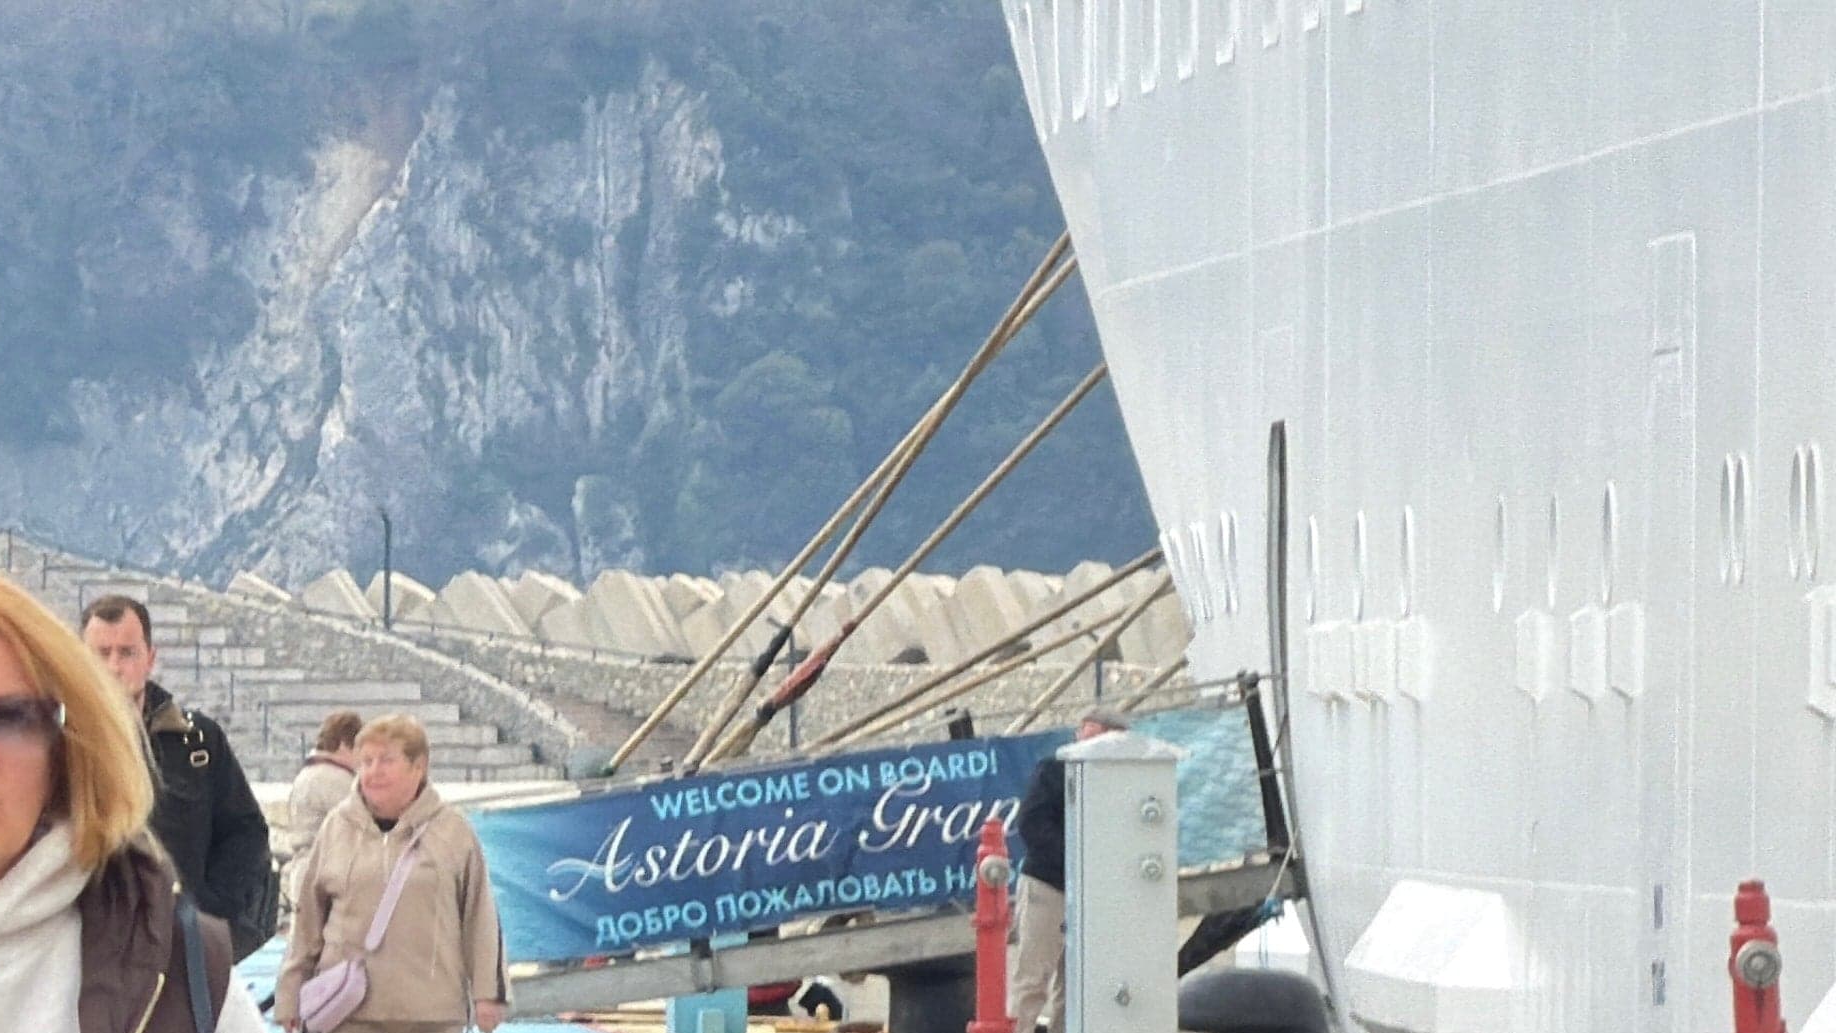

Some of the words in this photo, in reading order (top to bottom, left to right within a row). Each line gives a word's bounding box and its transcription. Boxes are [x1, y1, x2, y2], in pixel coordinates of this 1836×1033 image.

[650, 771, 811, 820] WELCOME
[817, 764, 871, 796] ON
[879, 748, 998, 788] BOARD!
[546, 806, 840, 902] Astoria
[858, 772, 1022, 853] Gran
[595, 899, 708, 948] ДОБРО
[714, 867, 937, 923] ПОЖАЛОВАТЬ
